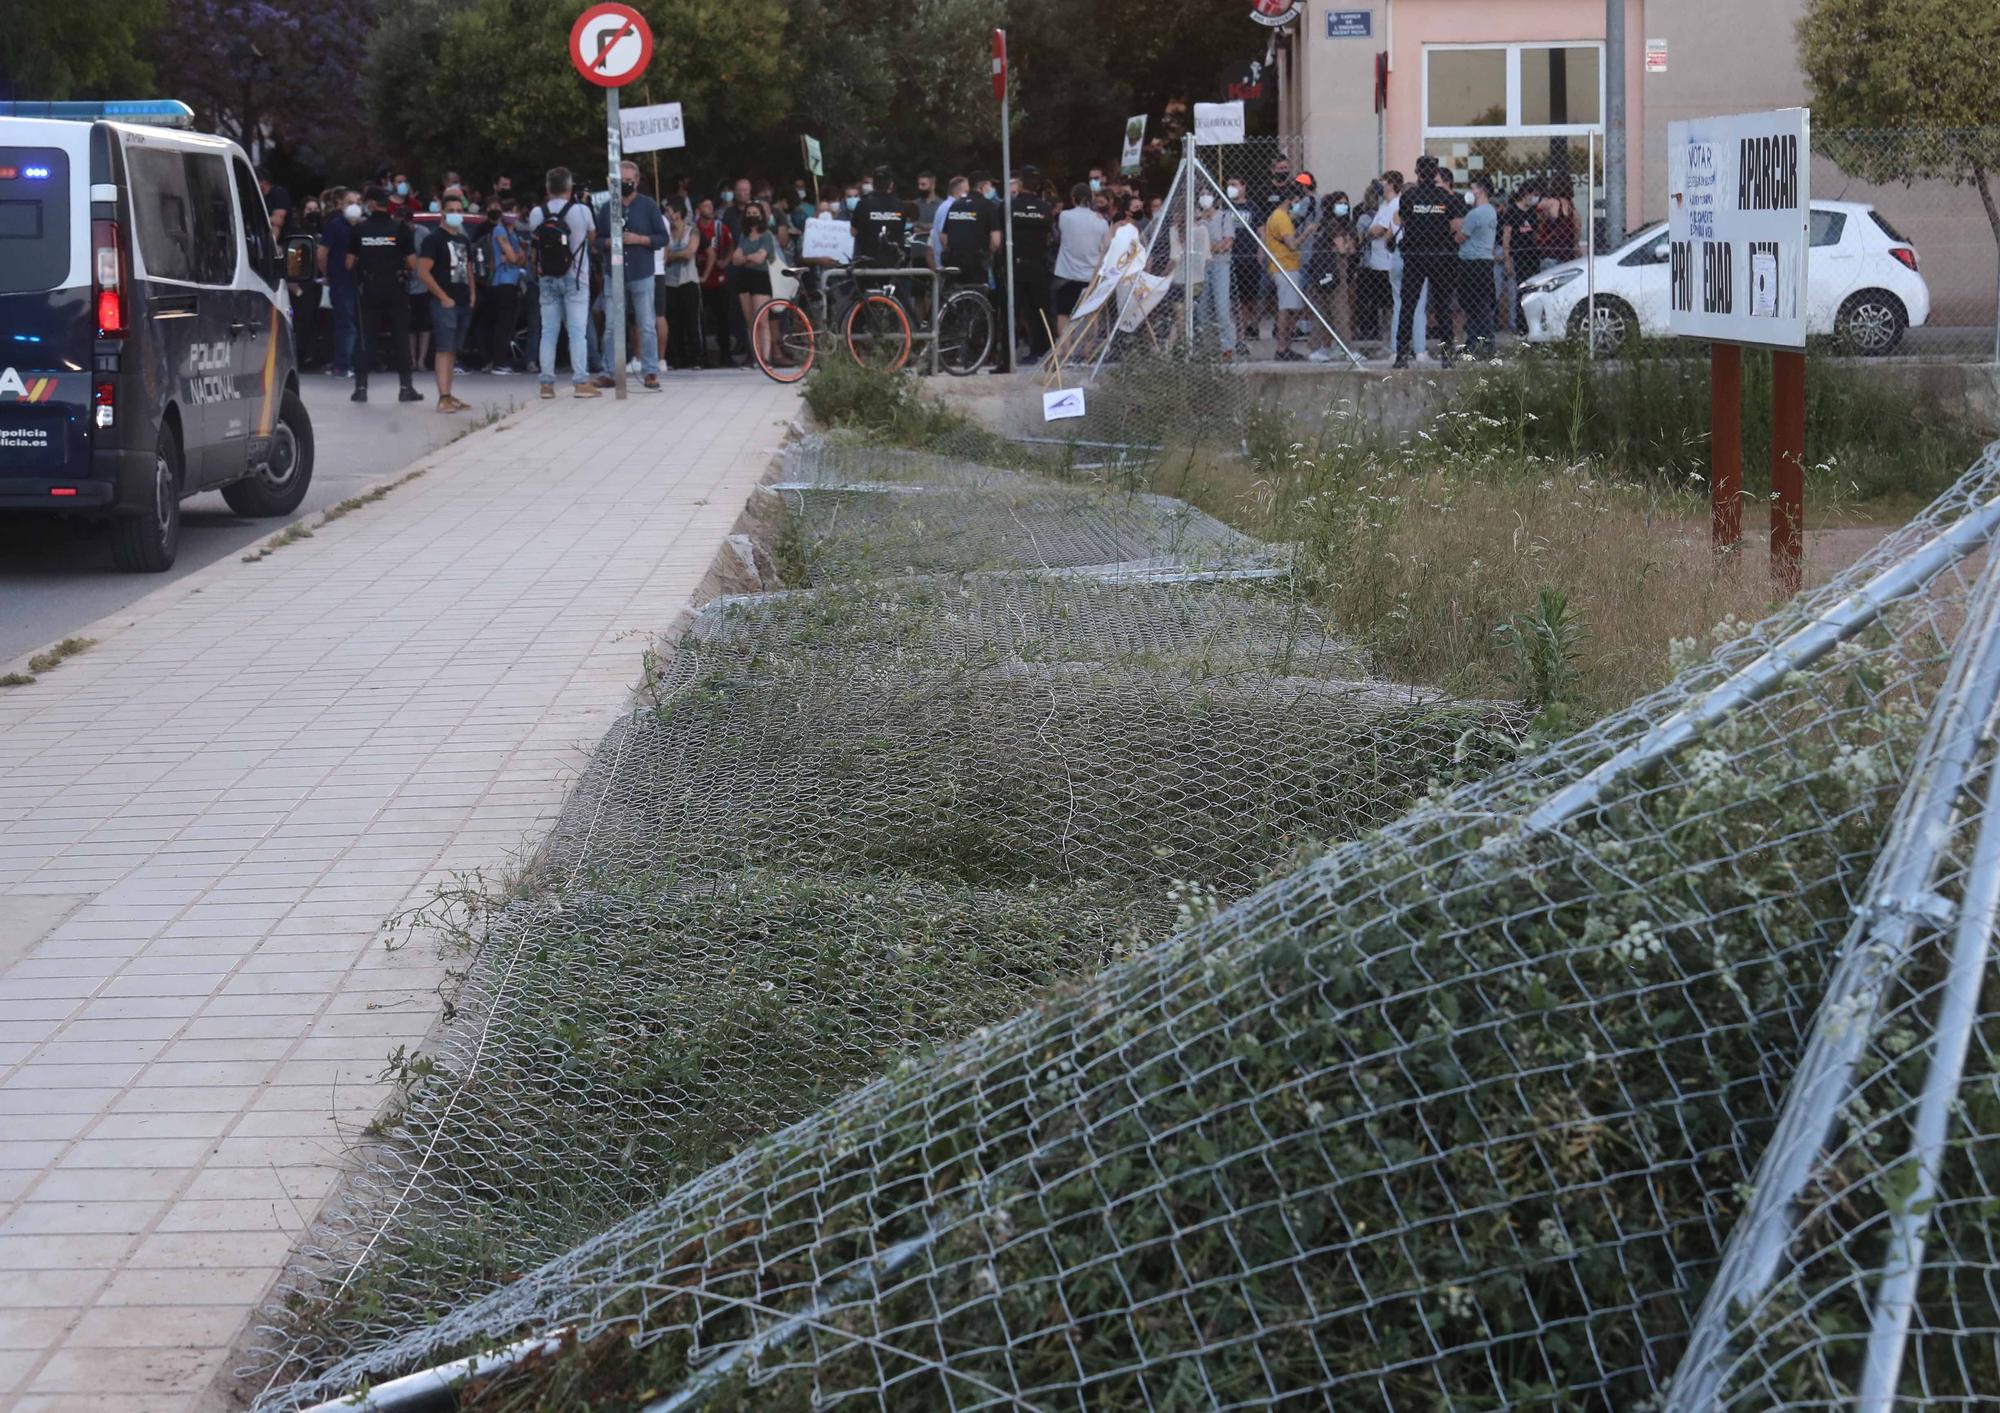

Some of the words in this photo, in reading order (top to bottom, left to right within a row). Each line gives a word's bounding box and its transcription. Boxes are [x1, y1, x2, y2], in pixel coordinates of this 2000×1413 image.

[1688, 145, 1712, 169] VOTAR
[1738, 134, 1798, 210] APARCAR
[190, 375, 241, 406] NACIONAL
